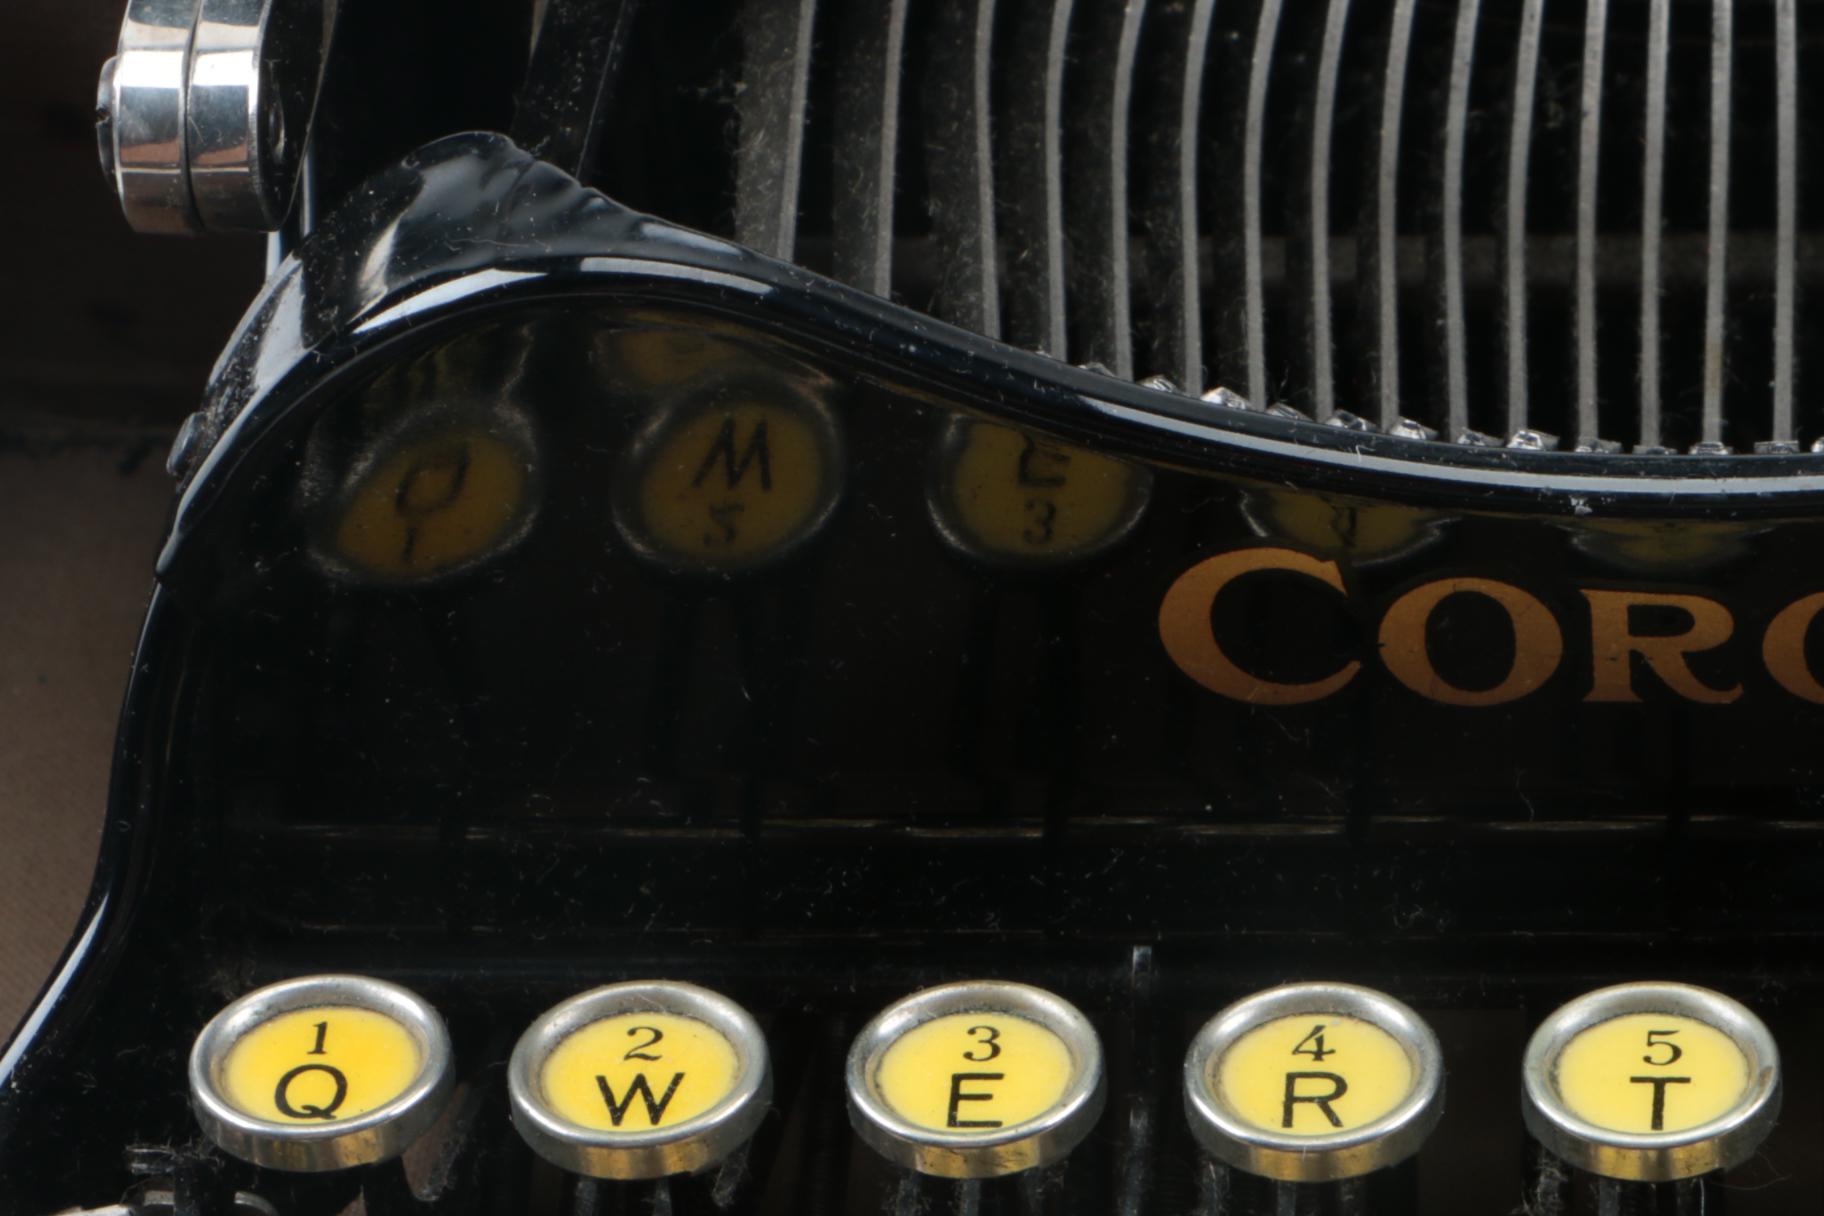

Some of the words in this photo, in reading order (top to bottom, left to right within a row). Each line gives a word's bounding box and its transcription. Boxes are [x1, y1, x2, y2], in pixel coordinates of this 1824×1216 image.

[308, 1021, 327, 1054] 1
[624, 1027, 663, 1061] 2
[963, 1026, 1001, 1061] 3
[1292, 1025, 1335, 1061] 4
[1643, 1030, 1682, 1065] 5
[274, 1064, 347, 1120] Q
[596, 1072, 684, 1126] W
[947, 1072, 1004, 1128] E
[1282, 1071, 1348, 1128] R
[1630, 1076, 1691, 1131] T
